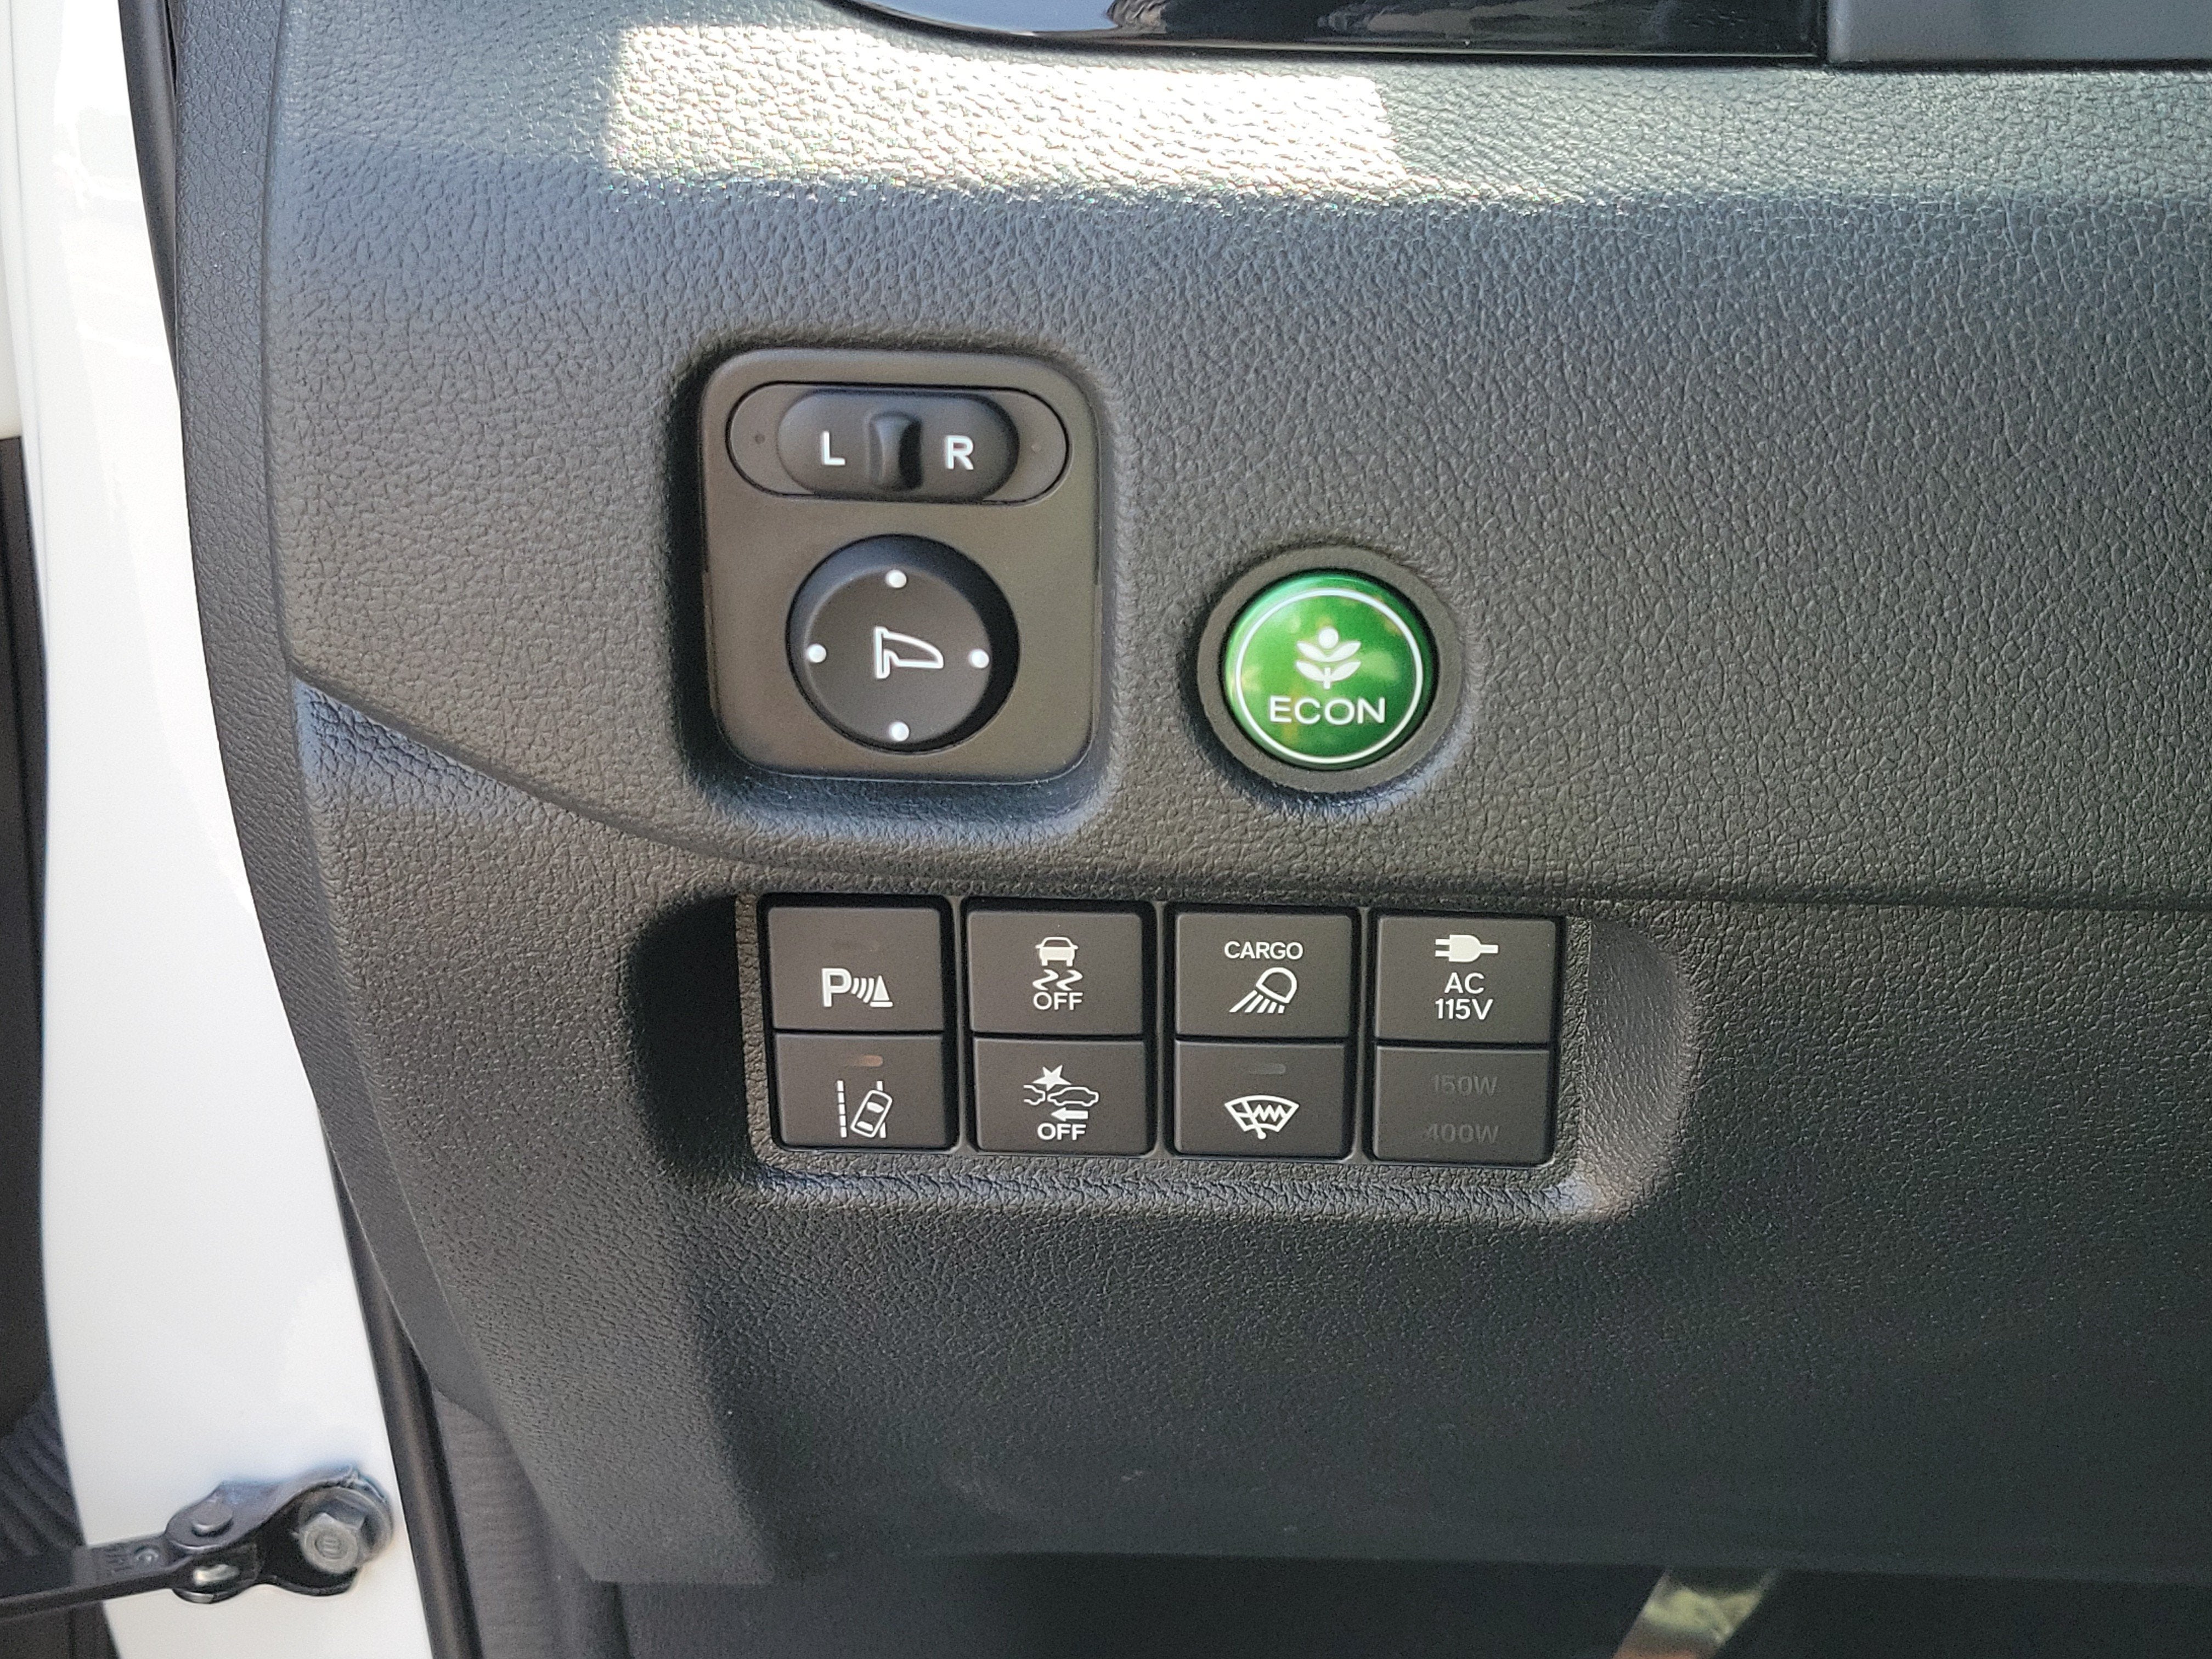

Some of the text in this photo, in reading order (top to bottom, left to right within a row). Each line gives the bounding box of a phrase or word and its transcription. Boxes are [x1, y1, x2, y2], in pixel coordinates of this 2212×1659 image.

[822, 431, 845, 466] L
[945, 436, 974, 470] R
[1269, 695, 1386, 725] ECON
[1224, 941, 1304, 960] CARGO
[822, 968, 852, 1007] P
[1444, 973, 1485, 994] AC
[1032, 992, 1083, 1011] OFF
[1435, 998, 1493, 1020] 115V
[1432, 1075, 1497, 1096] 150W
[1037, 1123, 1086, 1141] OFF
[1426, 1124, 1498, 1144] 400W
